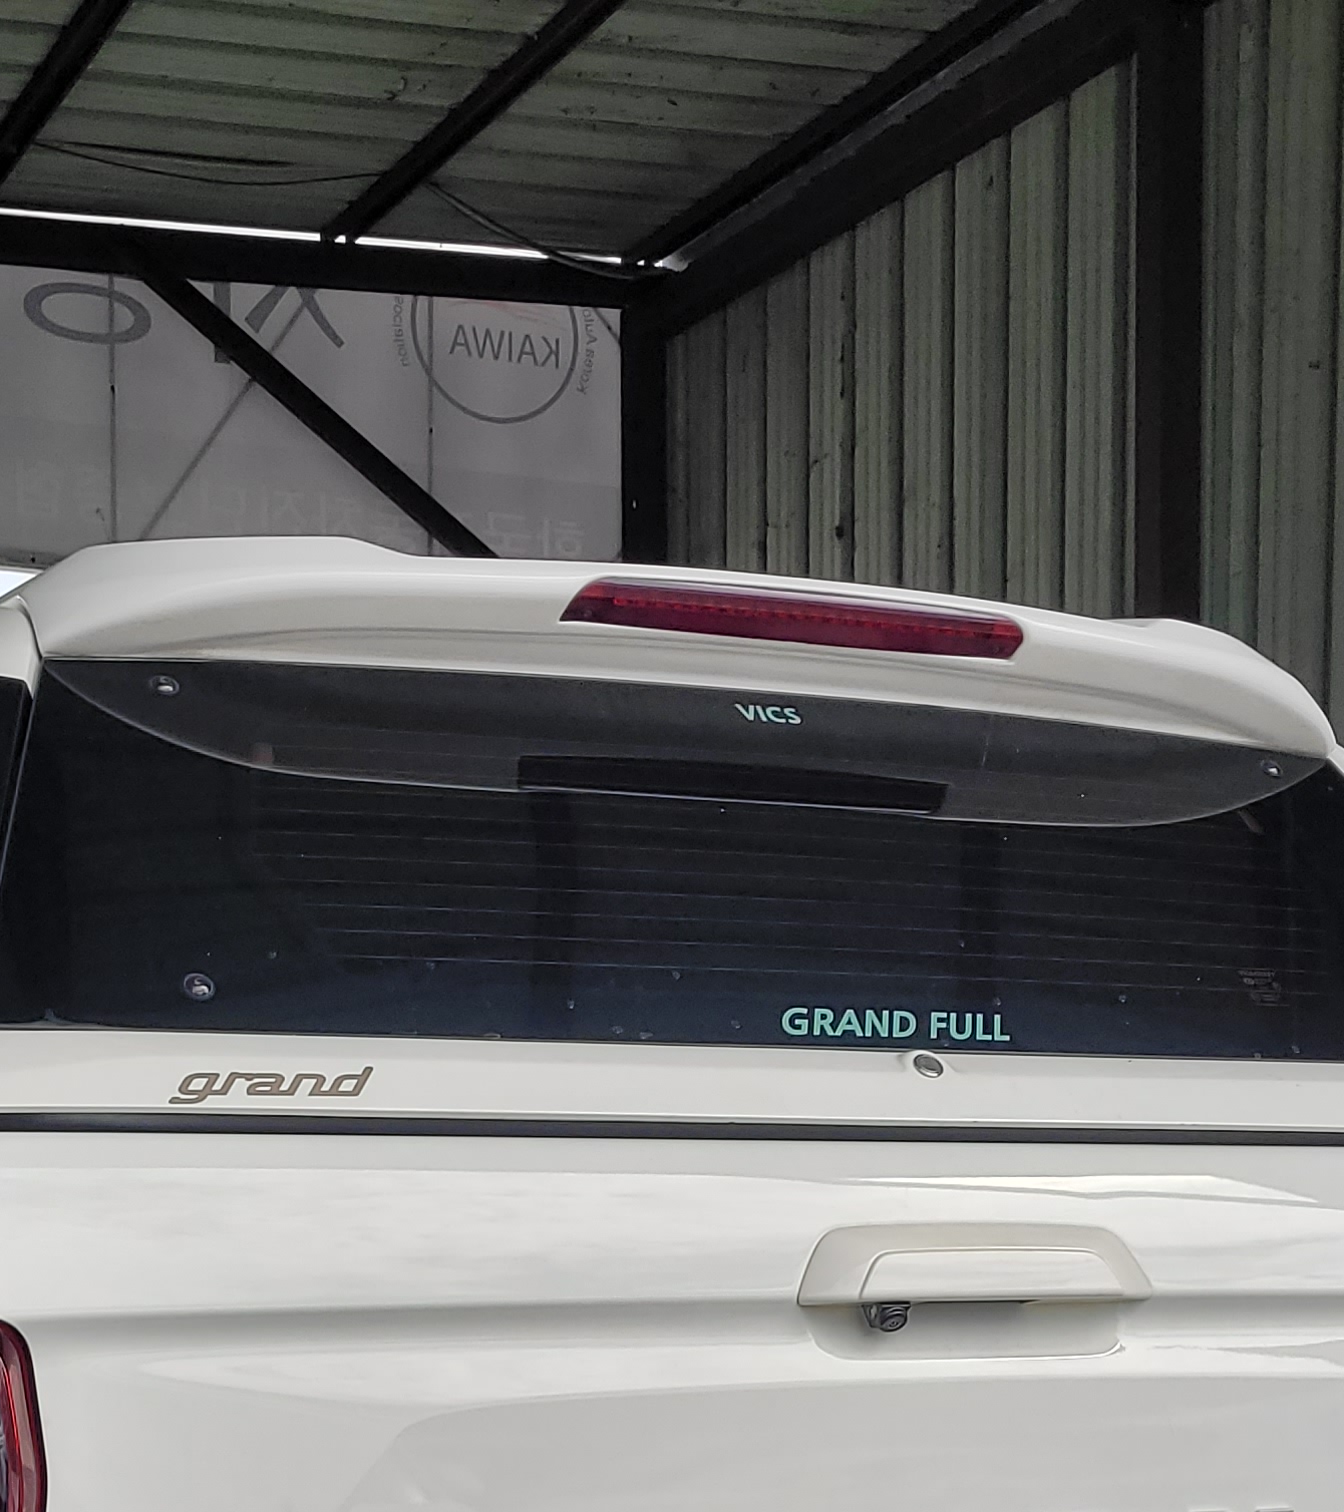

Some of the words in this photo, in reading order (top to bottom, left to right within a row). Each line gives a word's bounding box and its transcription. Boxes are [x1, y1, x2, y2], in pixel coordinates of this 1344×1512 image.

[735, 703, 802, 725] VICS
[781, 1007, 917, 1039] GRAND
[930, 1012, 1010, 1042] FULL
[168, 1066, 373, 1104] grand
